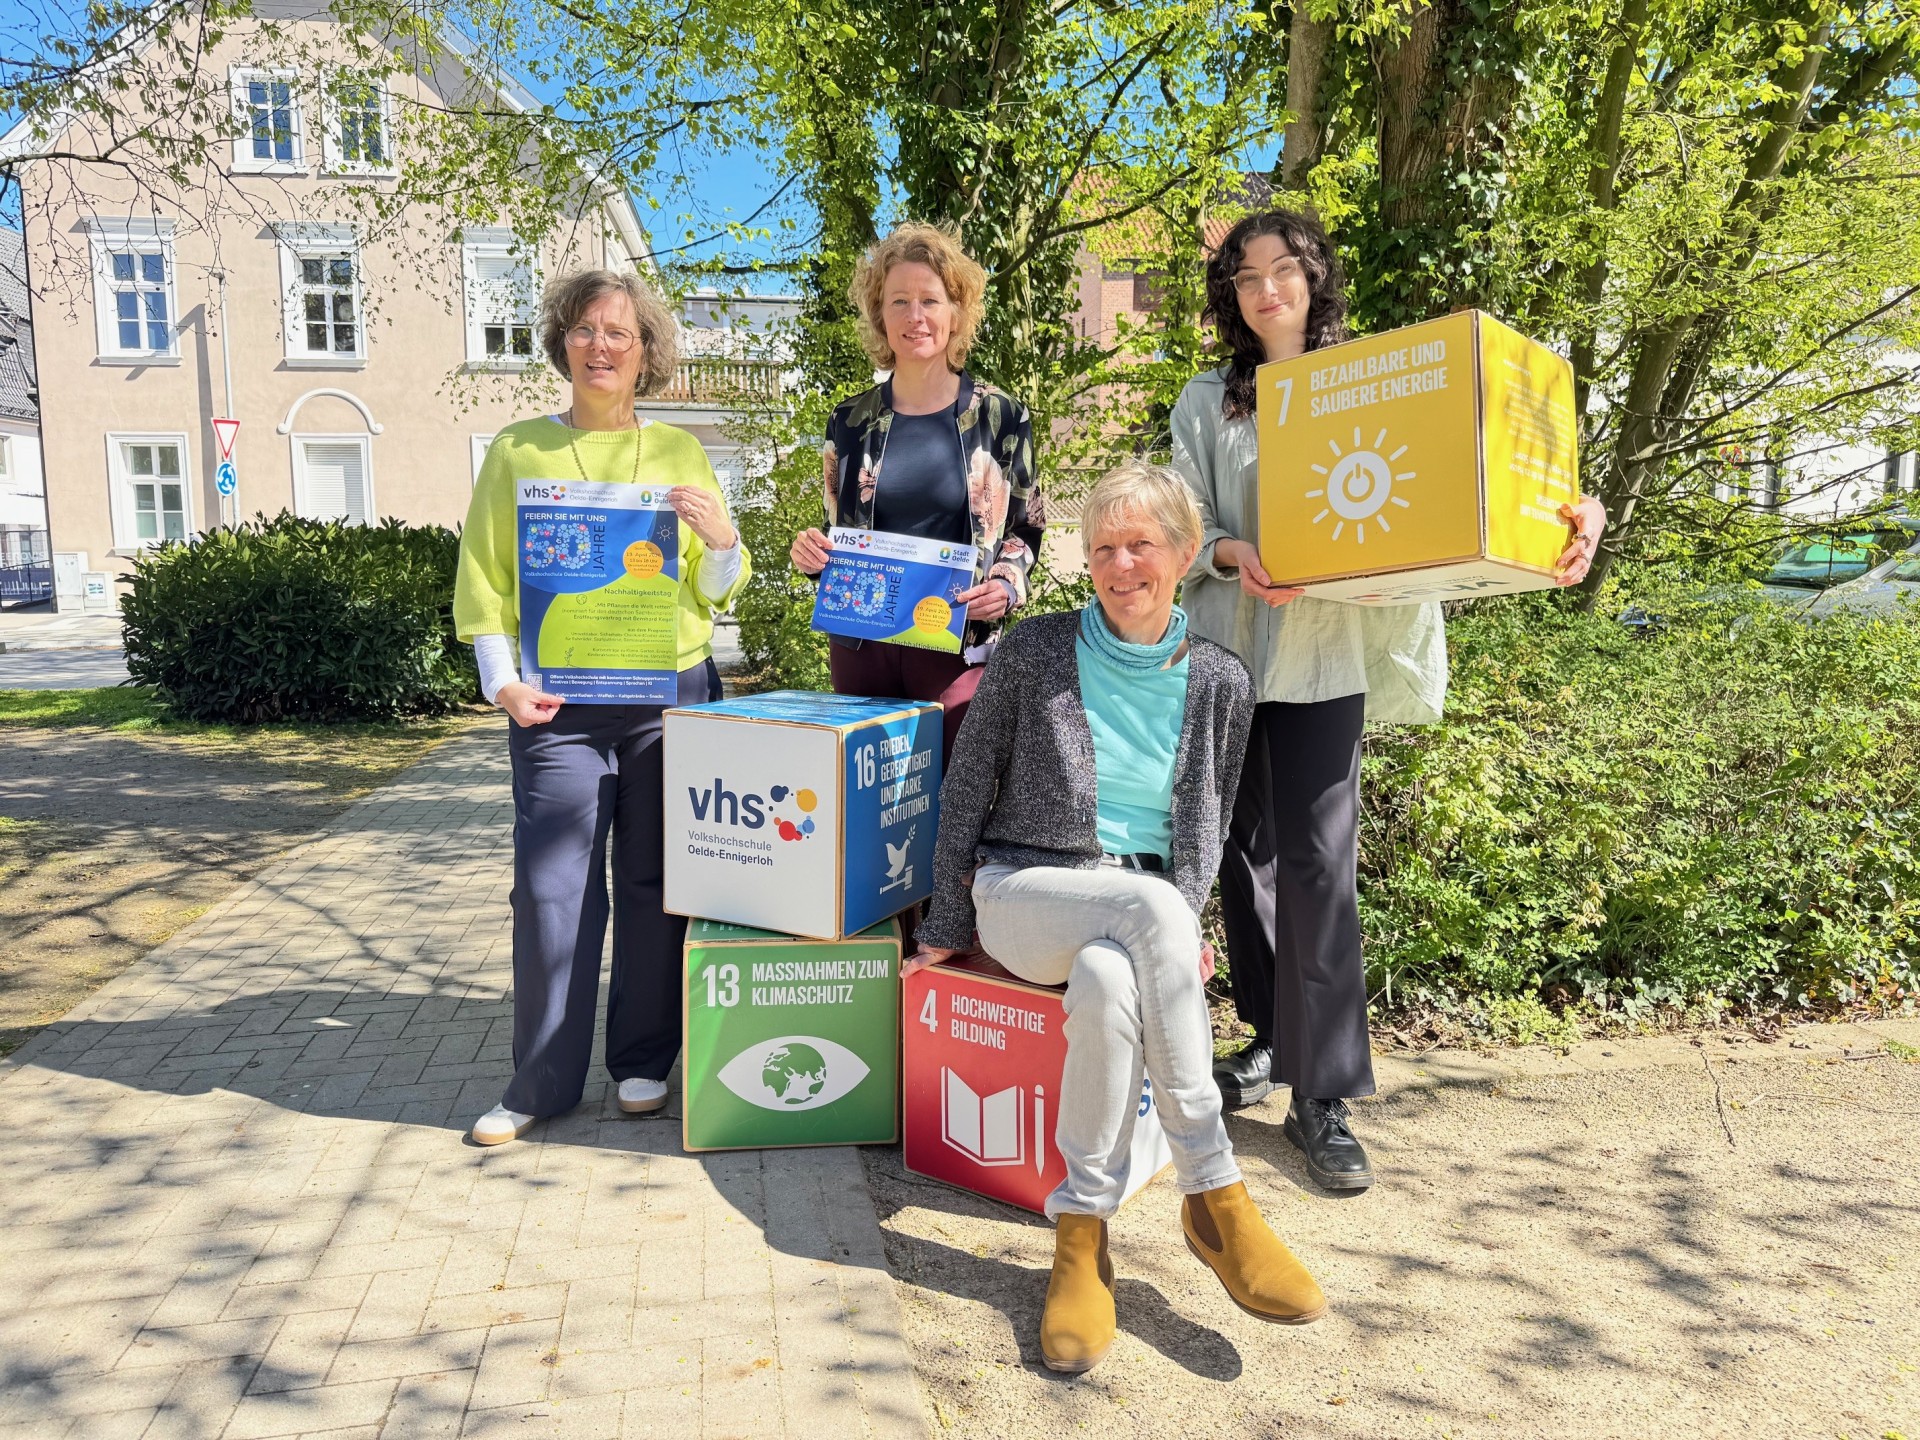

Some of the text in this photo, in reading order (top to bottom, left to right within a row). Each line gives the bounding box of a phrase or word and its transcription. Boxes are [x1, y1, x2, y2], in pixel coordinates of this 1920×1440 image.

[1310, 340, 1446, 392] BEZAHLBARE UND
[1276, 378, 1293, 427] 7
[1310, 367, 1448, 418] SAUBERE ENERGIE
[524, 485, 550, 498] vhs
[570, 488, 616, 496] Volkshochschule
[570, 494, 618, 502] Oelde-Ennigerloh
[525, 512, 552, 520] FEIERN
[570, 514, 584, 522] MIT
[525, 522, 592, 570] 50
[593, 525, 606, 571] JAHRE
[834, 532, 856, 546] vhs
[874, 538, 918, 548] Volkshochschule
[874, 544, 918, 556] Oelde-Ennigerloh
[830, 556, 855, 566] FEIERN
[857, 560, 868, 568] SIE
[886, 566, 905, 574] UNS!
[604, 588, 672, 598] Nachhaltigkeitstag
[822, 567, 886, 616] 50
[884, 576, 902, 622] JAHRE
[818, 612, 896, 628] Volkshochschule Oelde-Ennigerloh
[880, 734, 912, 759] FRIEDEN,
[854, 744, 876, 790] 16
[880, 750, 932, 780] GERECHTIGKEIT
[688, 778, 765, 830] vhs
[880, 781, 922, 806] UND STARKE
[880, 794, 930, 830] INSTITUTIONEN
[688, 830, 772, 852] Volkshochschule
[688, 844, 773, 866] Oelde-Ennigerloh
[752, 960, 889, 982] MASSNAHMEN ZUM
[702, 964, 740, 1008] 13
[752, 984, 854, 1006] KLIMASCHUTZ
[920, 988, 938, 1033] 4
[951, 994, 1046, 1034] HOCHWERTIGE
[951, 1018, 1006, 1050] BILDUNG
